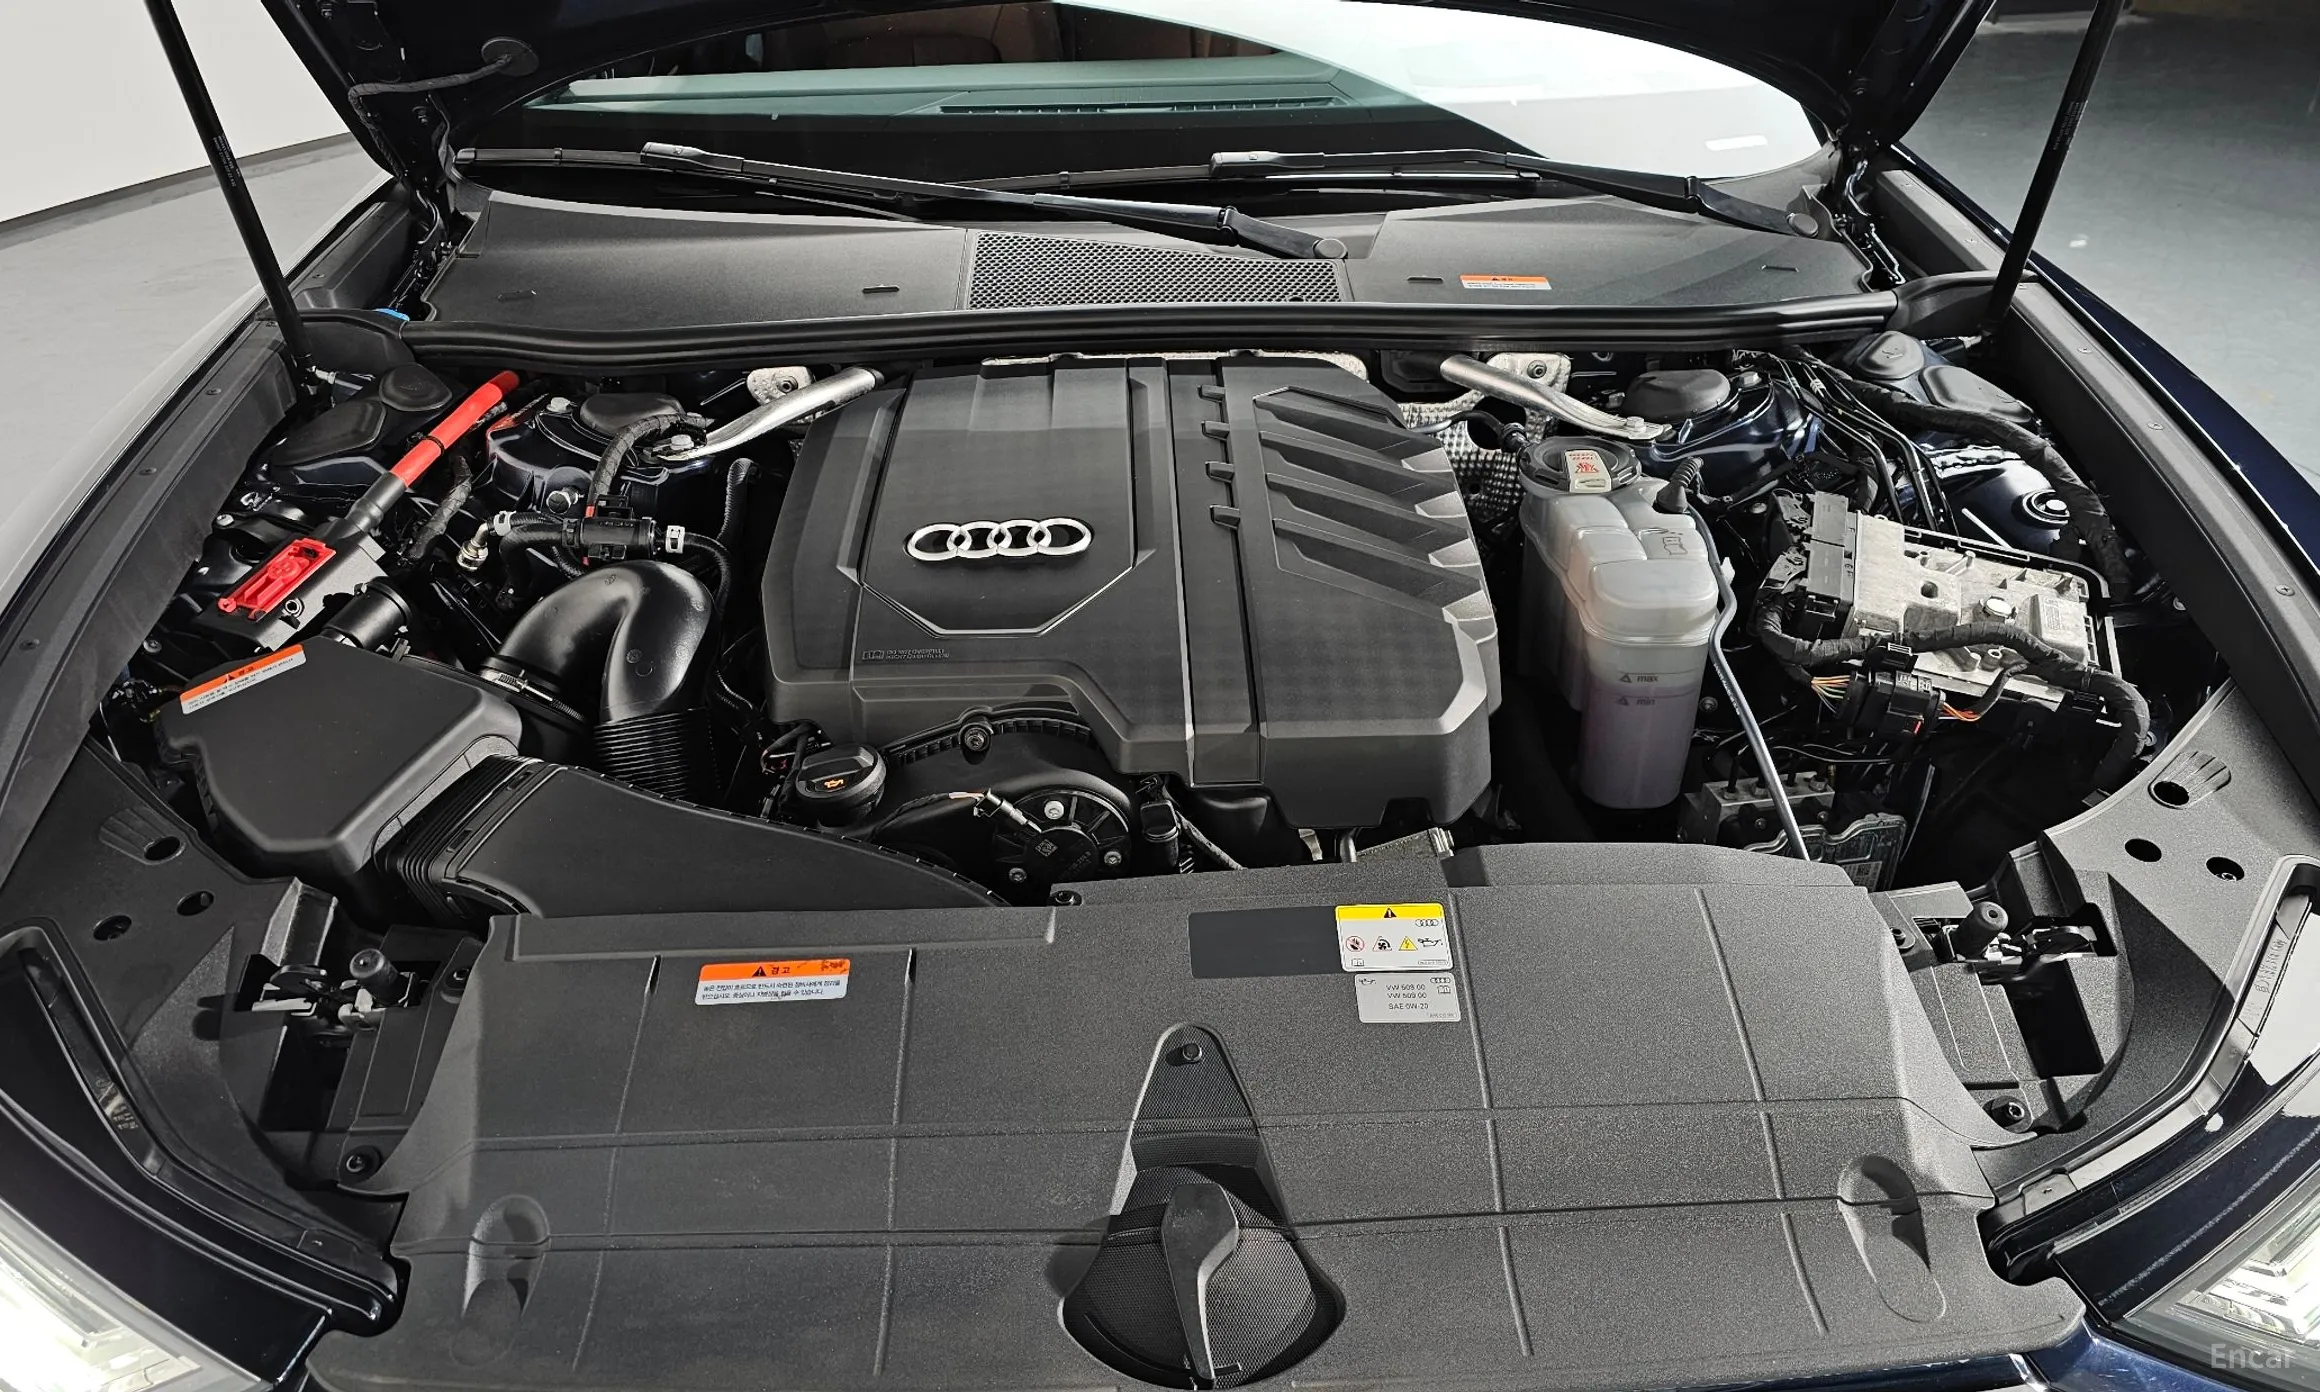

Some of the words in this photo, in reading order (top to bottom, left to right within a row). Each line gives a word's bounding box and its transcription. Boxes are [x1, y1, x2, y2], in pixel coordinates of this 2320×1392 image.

[1636, 675, 1659, 683] max
[1636, 697, 1656, 705] min
[1416, 983, 1426, 991] 00
